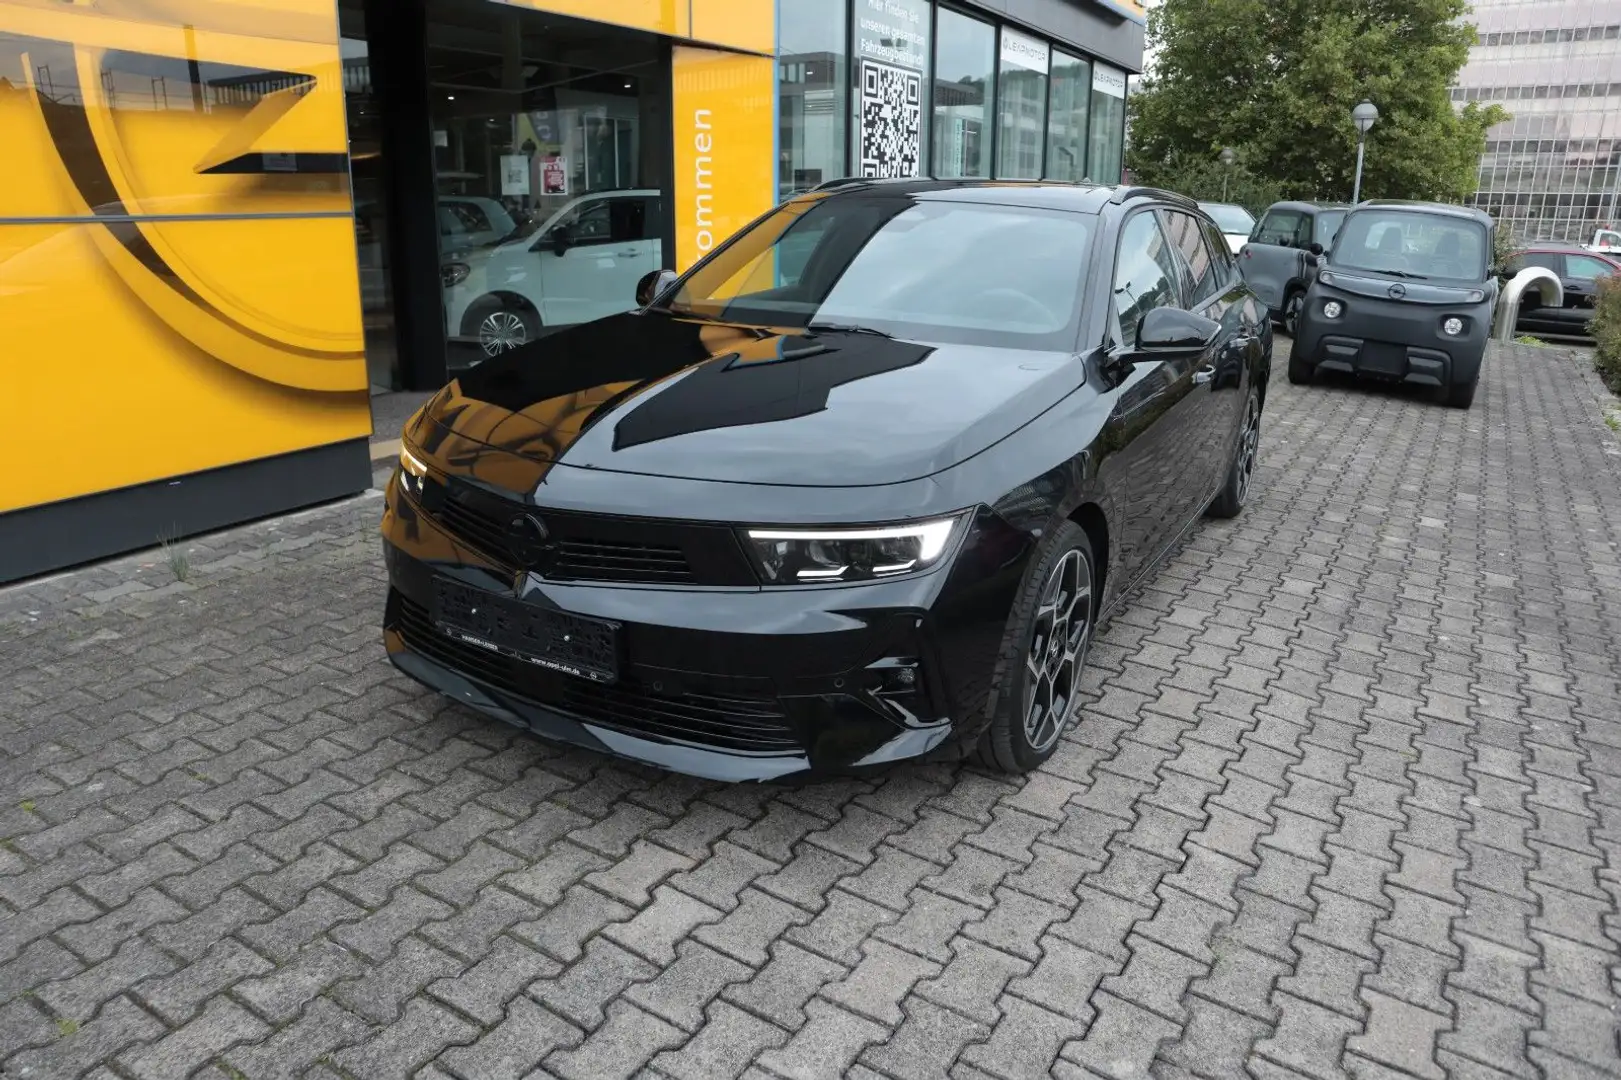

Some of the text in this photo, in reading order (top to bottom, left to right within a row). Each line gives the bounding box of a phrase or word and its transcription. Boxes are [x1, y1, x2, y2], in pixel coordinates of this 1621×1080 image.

[885, 0, 908, 18] finden
[909, 10, 920, 24] Sie
[891, 27, 925, 47] gesamten
[694, 108, 713, 264] ommen
